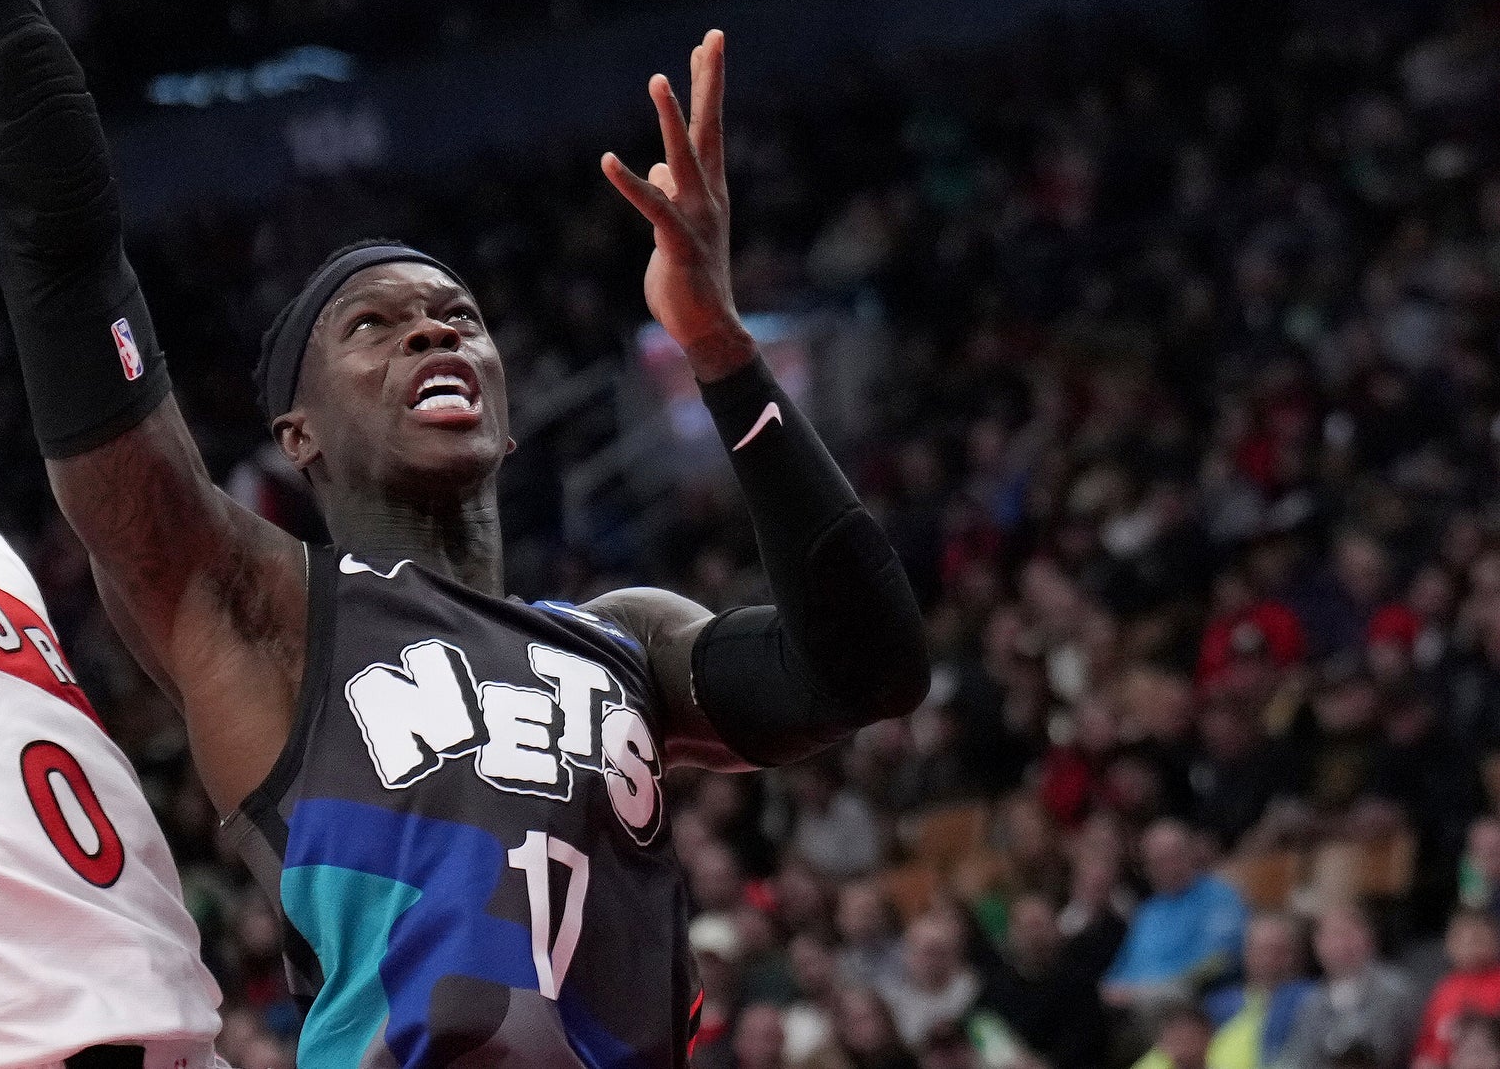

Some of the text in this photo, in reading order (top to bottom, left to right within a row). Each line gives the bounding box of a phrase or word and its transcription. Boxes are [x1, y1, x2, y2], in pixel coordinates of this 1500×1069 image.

[19, 739, 125, 889] 0
[344, 638, 663, 845] NETS
[508, 830, 590, 1000] 17
